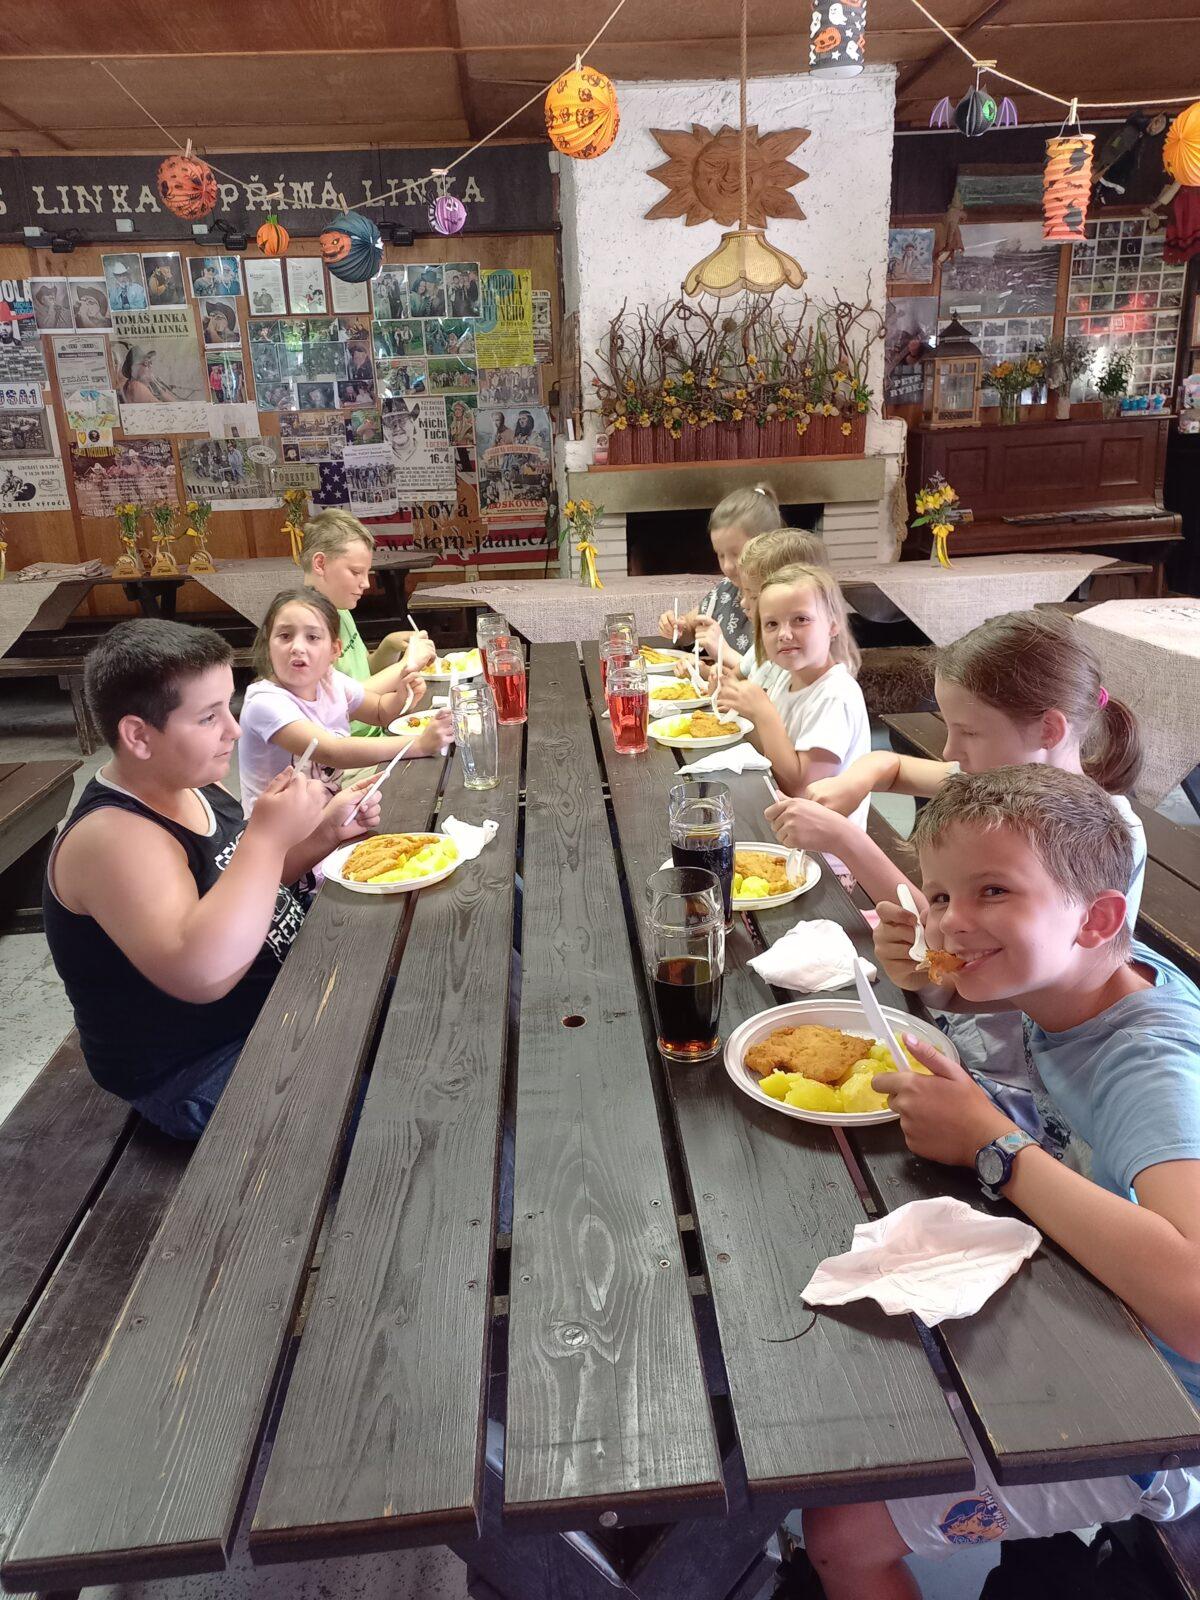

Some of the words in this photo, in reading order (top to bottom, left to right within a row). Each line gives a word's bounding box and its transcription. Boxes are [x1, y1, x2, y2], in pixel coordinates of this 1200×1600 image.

[32, 185, 162, 214] LINKA
[217, 172, 342, 212] PŘÍMÁ
[361, 176, 485, 208] LINKA
[113, 312, 150, 324] TOMÁŠ
[152, 313, 188, 324] LINKA
[123, 324, 157, 335] PŘÍMÁ
[158, 325, 189, 333] LINKA
[424, 428, 447, 440] Tučn
